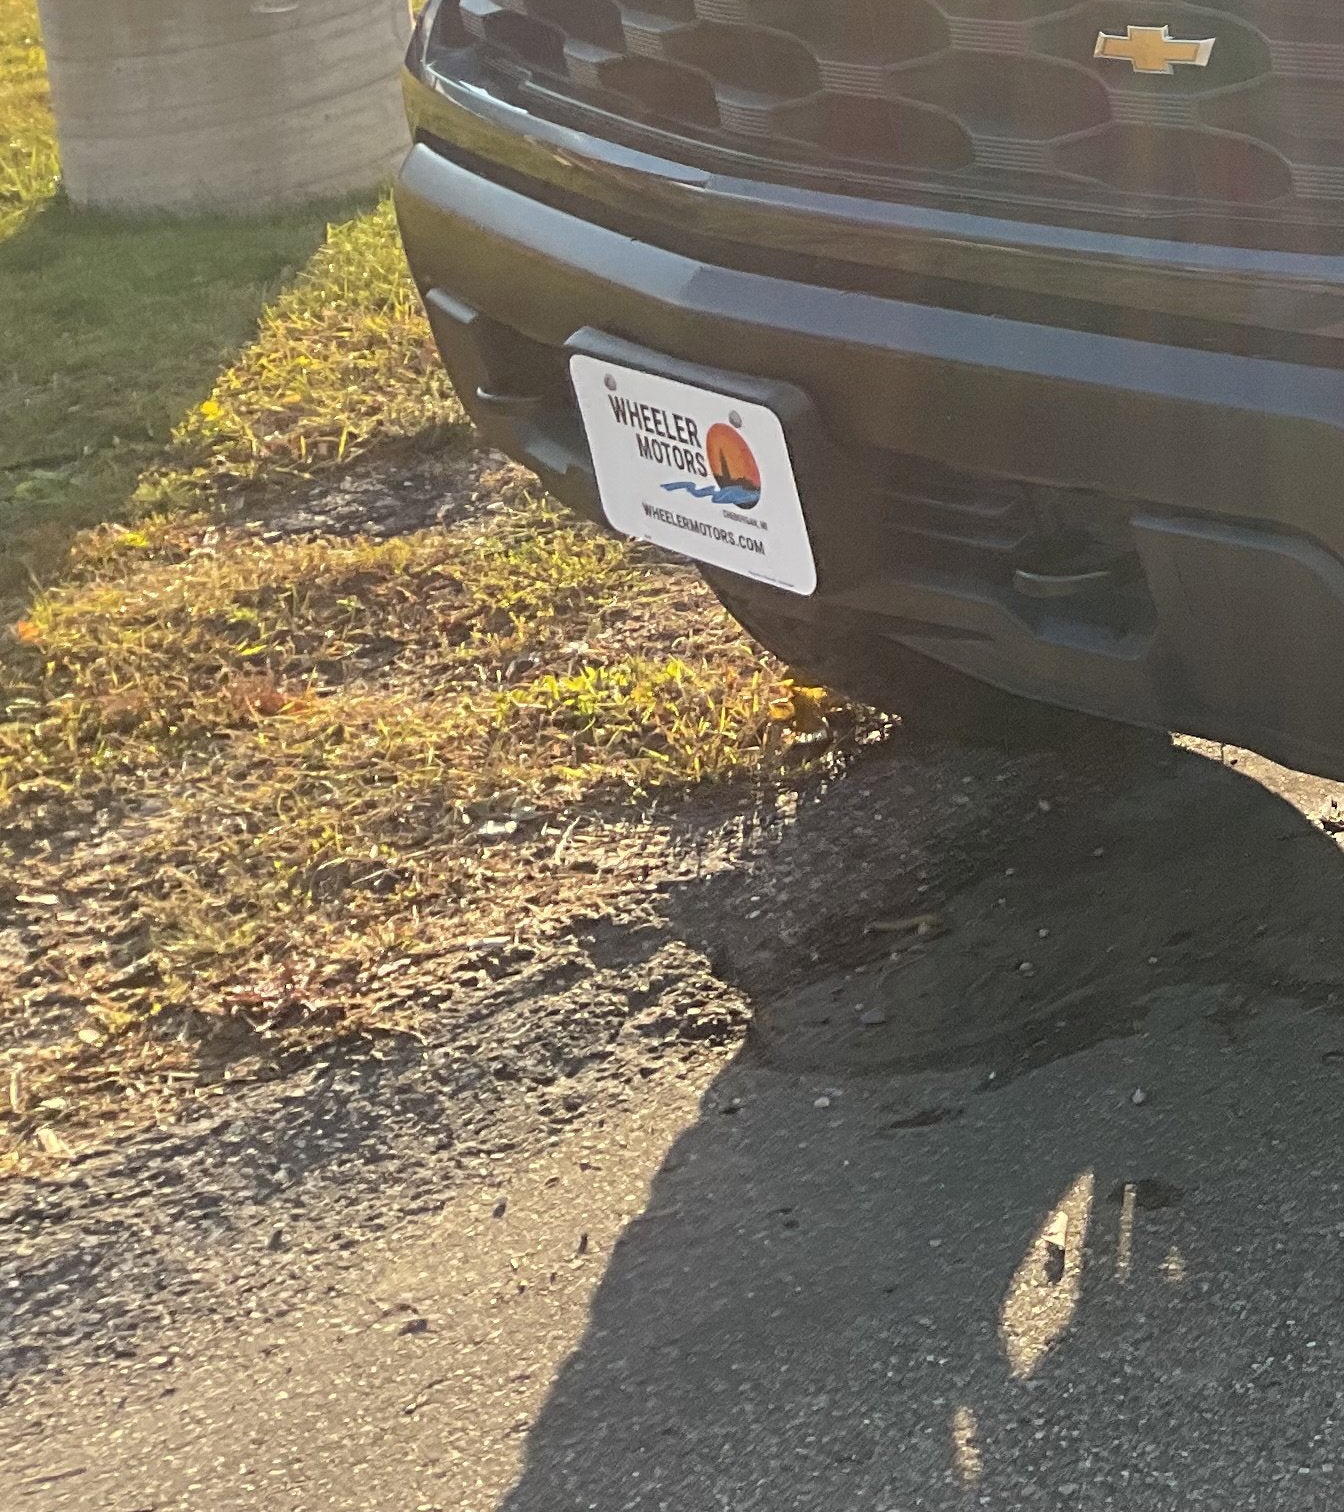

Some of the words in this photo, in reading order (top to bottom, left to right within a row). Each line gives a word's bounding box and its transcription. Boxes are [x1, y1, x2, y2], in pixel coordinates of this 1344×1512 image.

[608, 394, 702, 448] WHEELER
[636, 432, 708, 477] MOTORS
[642, 502, 766, 555] WHEELERMOTORS.COM
